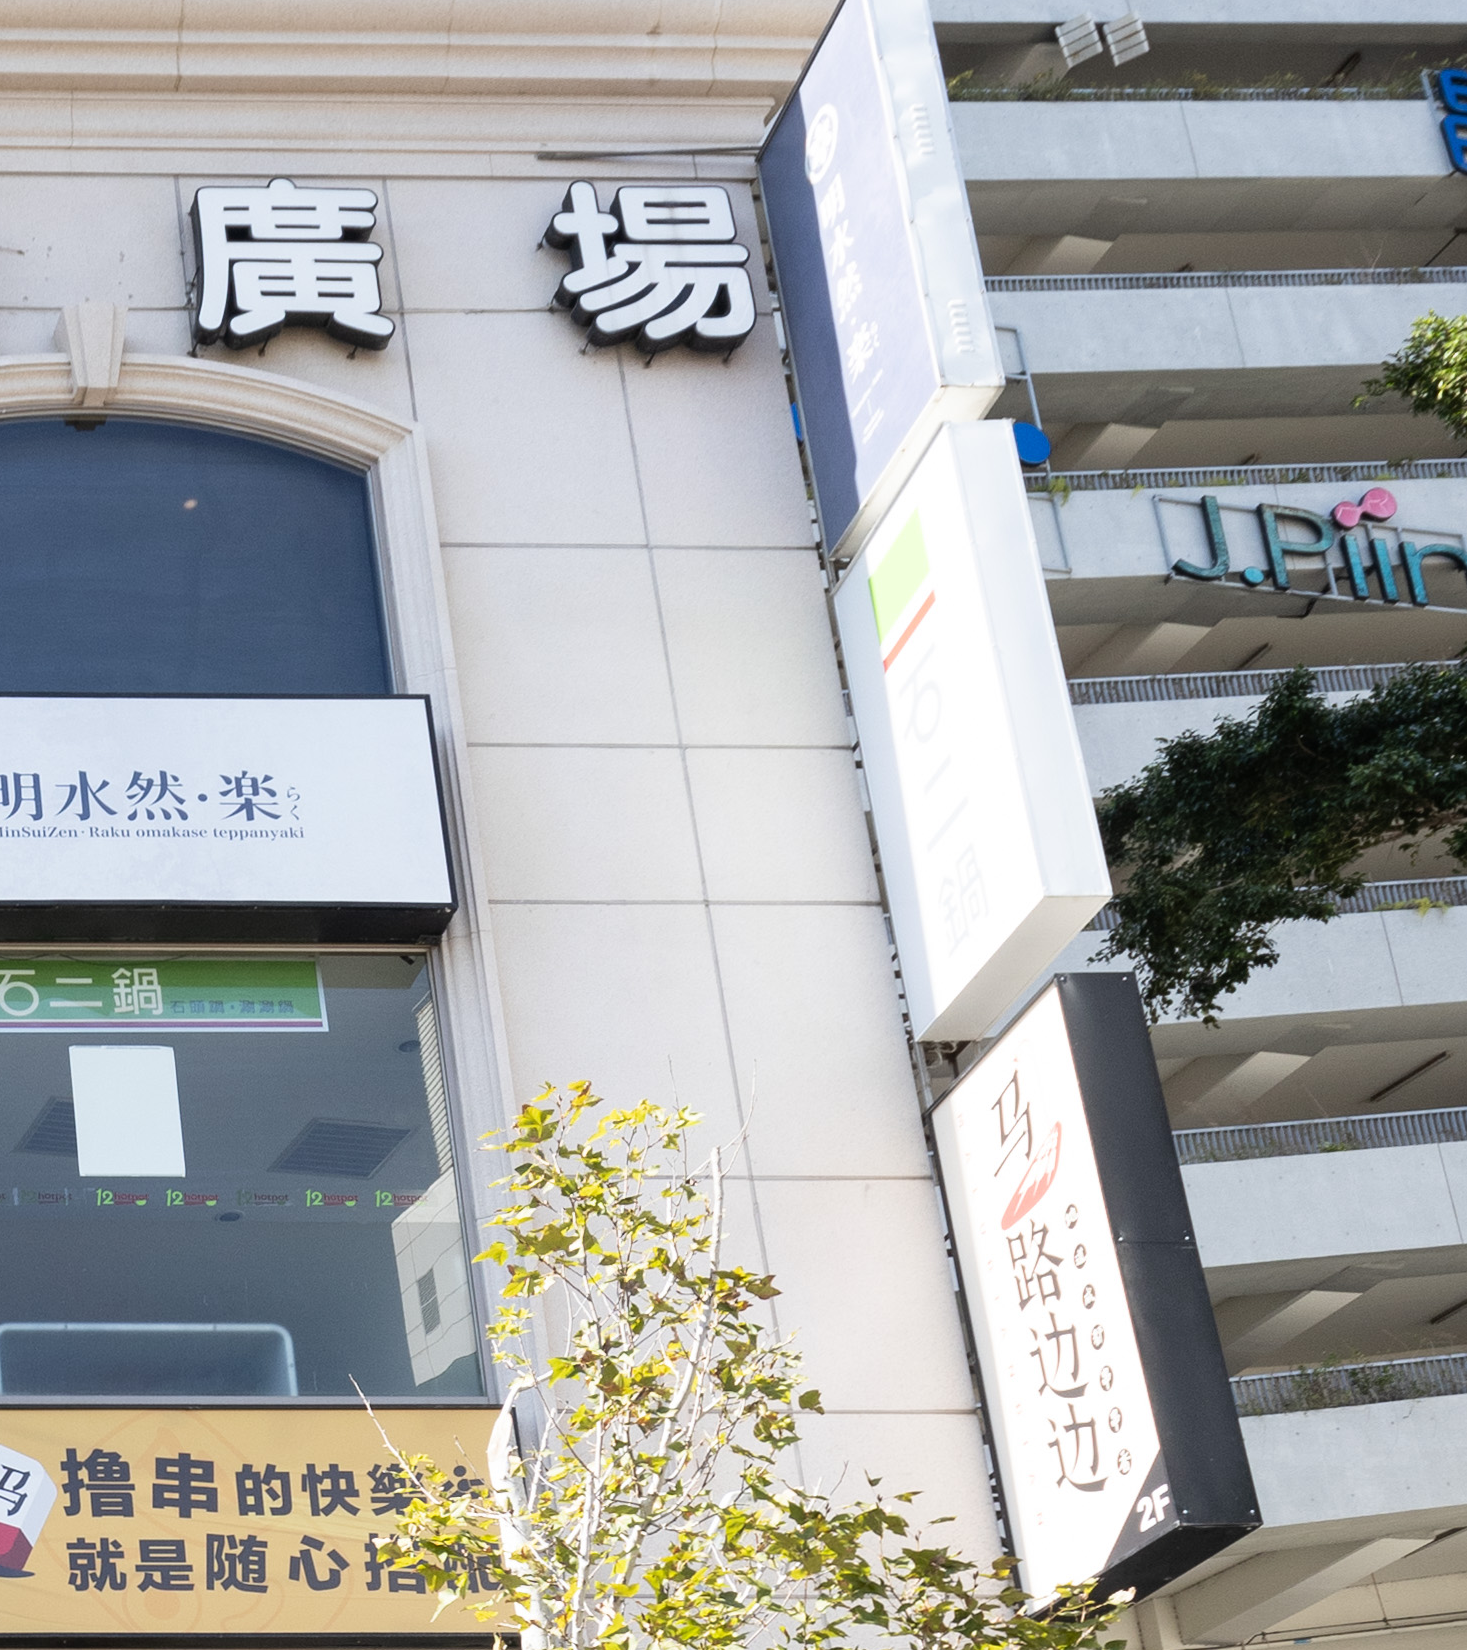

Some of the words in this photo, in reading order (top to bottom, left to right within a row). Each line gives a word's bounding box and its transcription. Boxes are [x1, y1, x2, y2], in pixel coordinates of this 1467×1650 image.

[88, 825, 131, 839] Raku
[136, 825, 208, 839] omakase
[213, 826, 305, 841] teppanyaki
[1135, 1484, 1172, 1536] 2F
